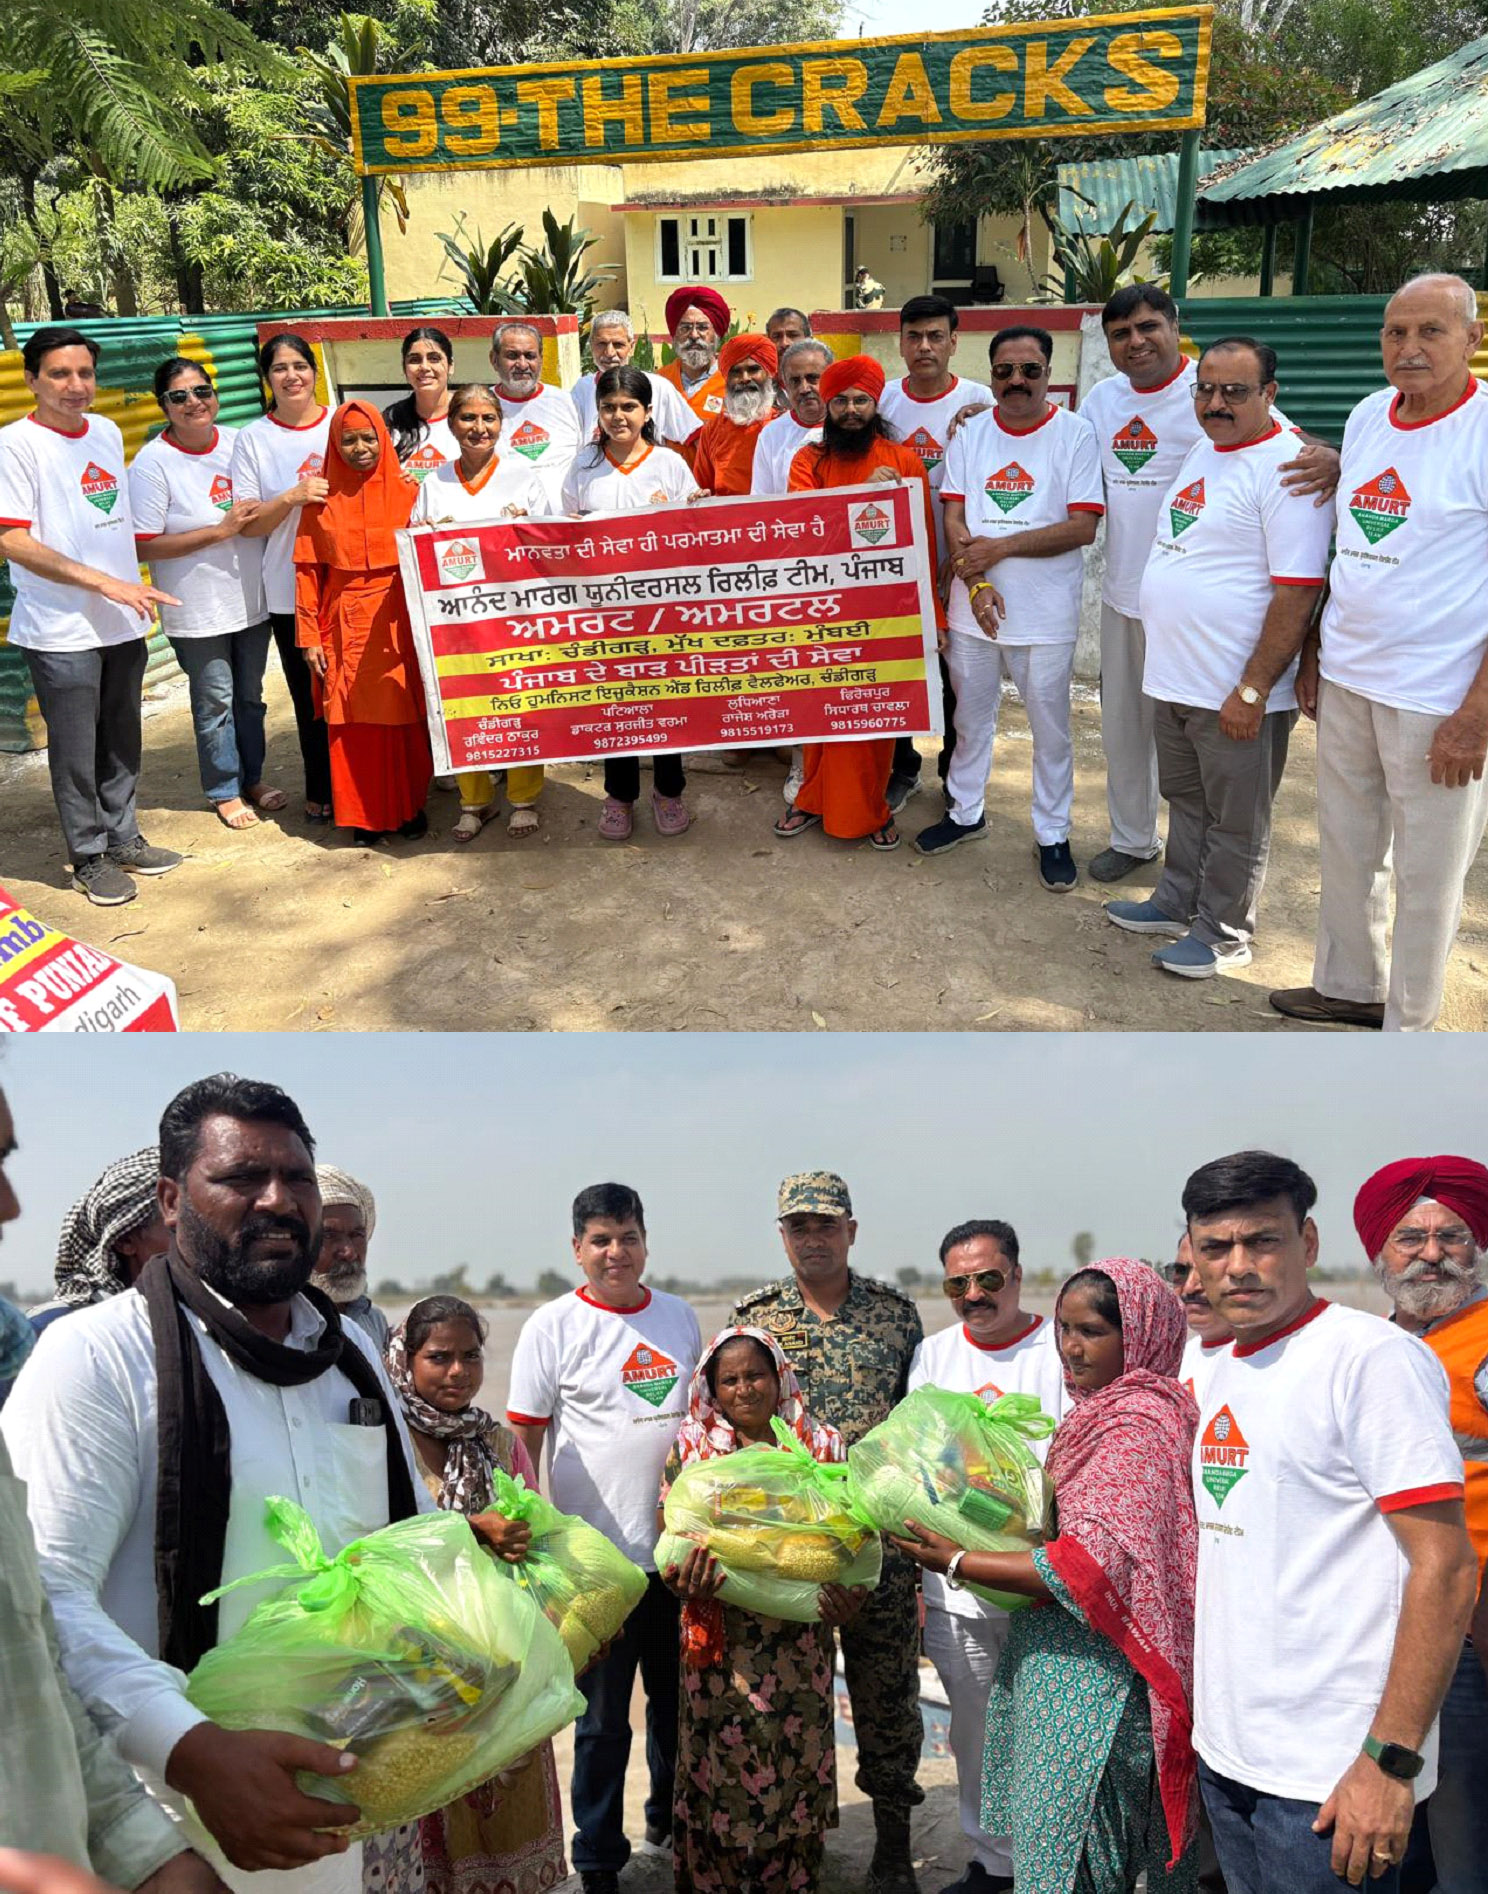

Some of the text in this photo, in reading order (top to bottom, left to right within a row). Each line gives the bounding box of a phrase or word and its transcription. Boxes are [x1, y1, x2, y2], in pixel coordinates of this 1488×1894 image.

[729, 31, 1184, 138] CRACKS
[511, 432, 550, 447] AMURT
[1112, 439, 1158, 450] AMURT
[916, 448, 943, 458] URT
[82, 480, 118, 495] AMURT
[984, 481, 1035, 491] AMURT
[1171, 497, 1204, 516] AMURT
[1349, 494, 1411, 516] AMURT
[854, 519, 891, 531] AMURT
[505, 515, 825, 562] ਮਾਨਵਤਾ ਦੀ ਸੇਵਾ ਹੀ ਪਰਮਾਤਮਾ ਦੀ ਸੇਵਾ ਹੈ
[442, 556, 477, 567] AMURT
[438, 585, 506, 617] ਆਨੰਦ
[511, 584, 577, 608] ਮਾਰਗ
[582, 569, 701, 608] ਯੂਨੀਵਰਸਲ
[783, 559, 835, 587] ਟੀਮ,
[841, 553, 904, 581] ਪੰਜਾਬ
[506, 610, 634, 639] ਅਮਰਟ
[675, 593, 842, 626] ਅਮਰਟਲ
[486, 649, 551, 668] ਸਾਖਾ:
[665, 633, 703, 652] ਮੁੱਖ
[803, 621, 871, 642] ਮੁੰਬਈ
[499, 669, 576, 690] ਪੰਜਾਬ
[584, 661, 607, 682] ਦੇ
[766, 647, 799, 669] ਦੀ
[805, 645, 862, 664] ਸੇਵਾ
[601, 704, 653, 717] ਪਟਿਆਲਾ
[656, 716, 688, 728] ਵਰਮਾ
[830, 716, 907, 730] 9815960775
[720, 723, 794, 738] 9815519173
[593, 733, 668, 749] 9872395499
[465, 745, 540, 762] 9815227315
[14, 944, 113, 1014] PUNJA
[622, 1365, 677, 1383] AMURT
